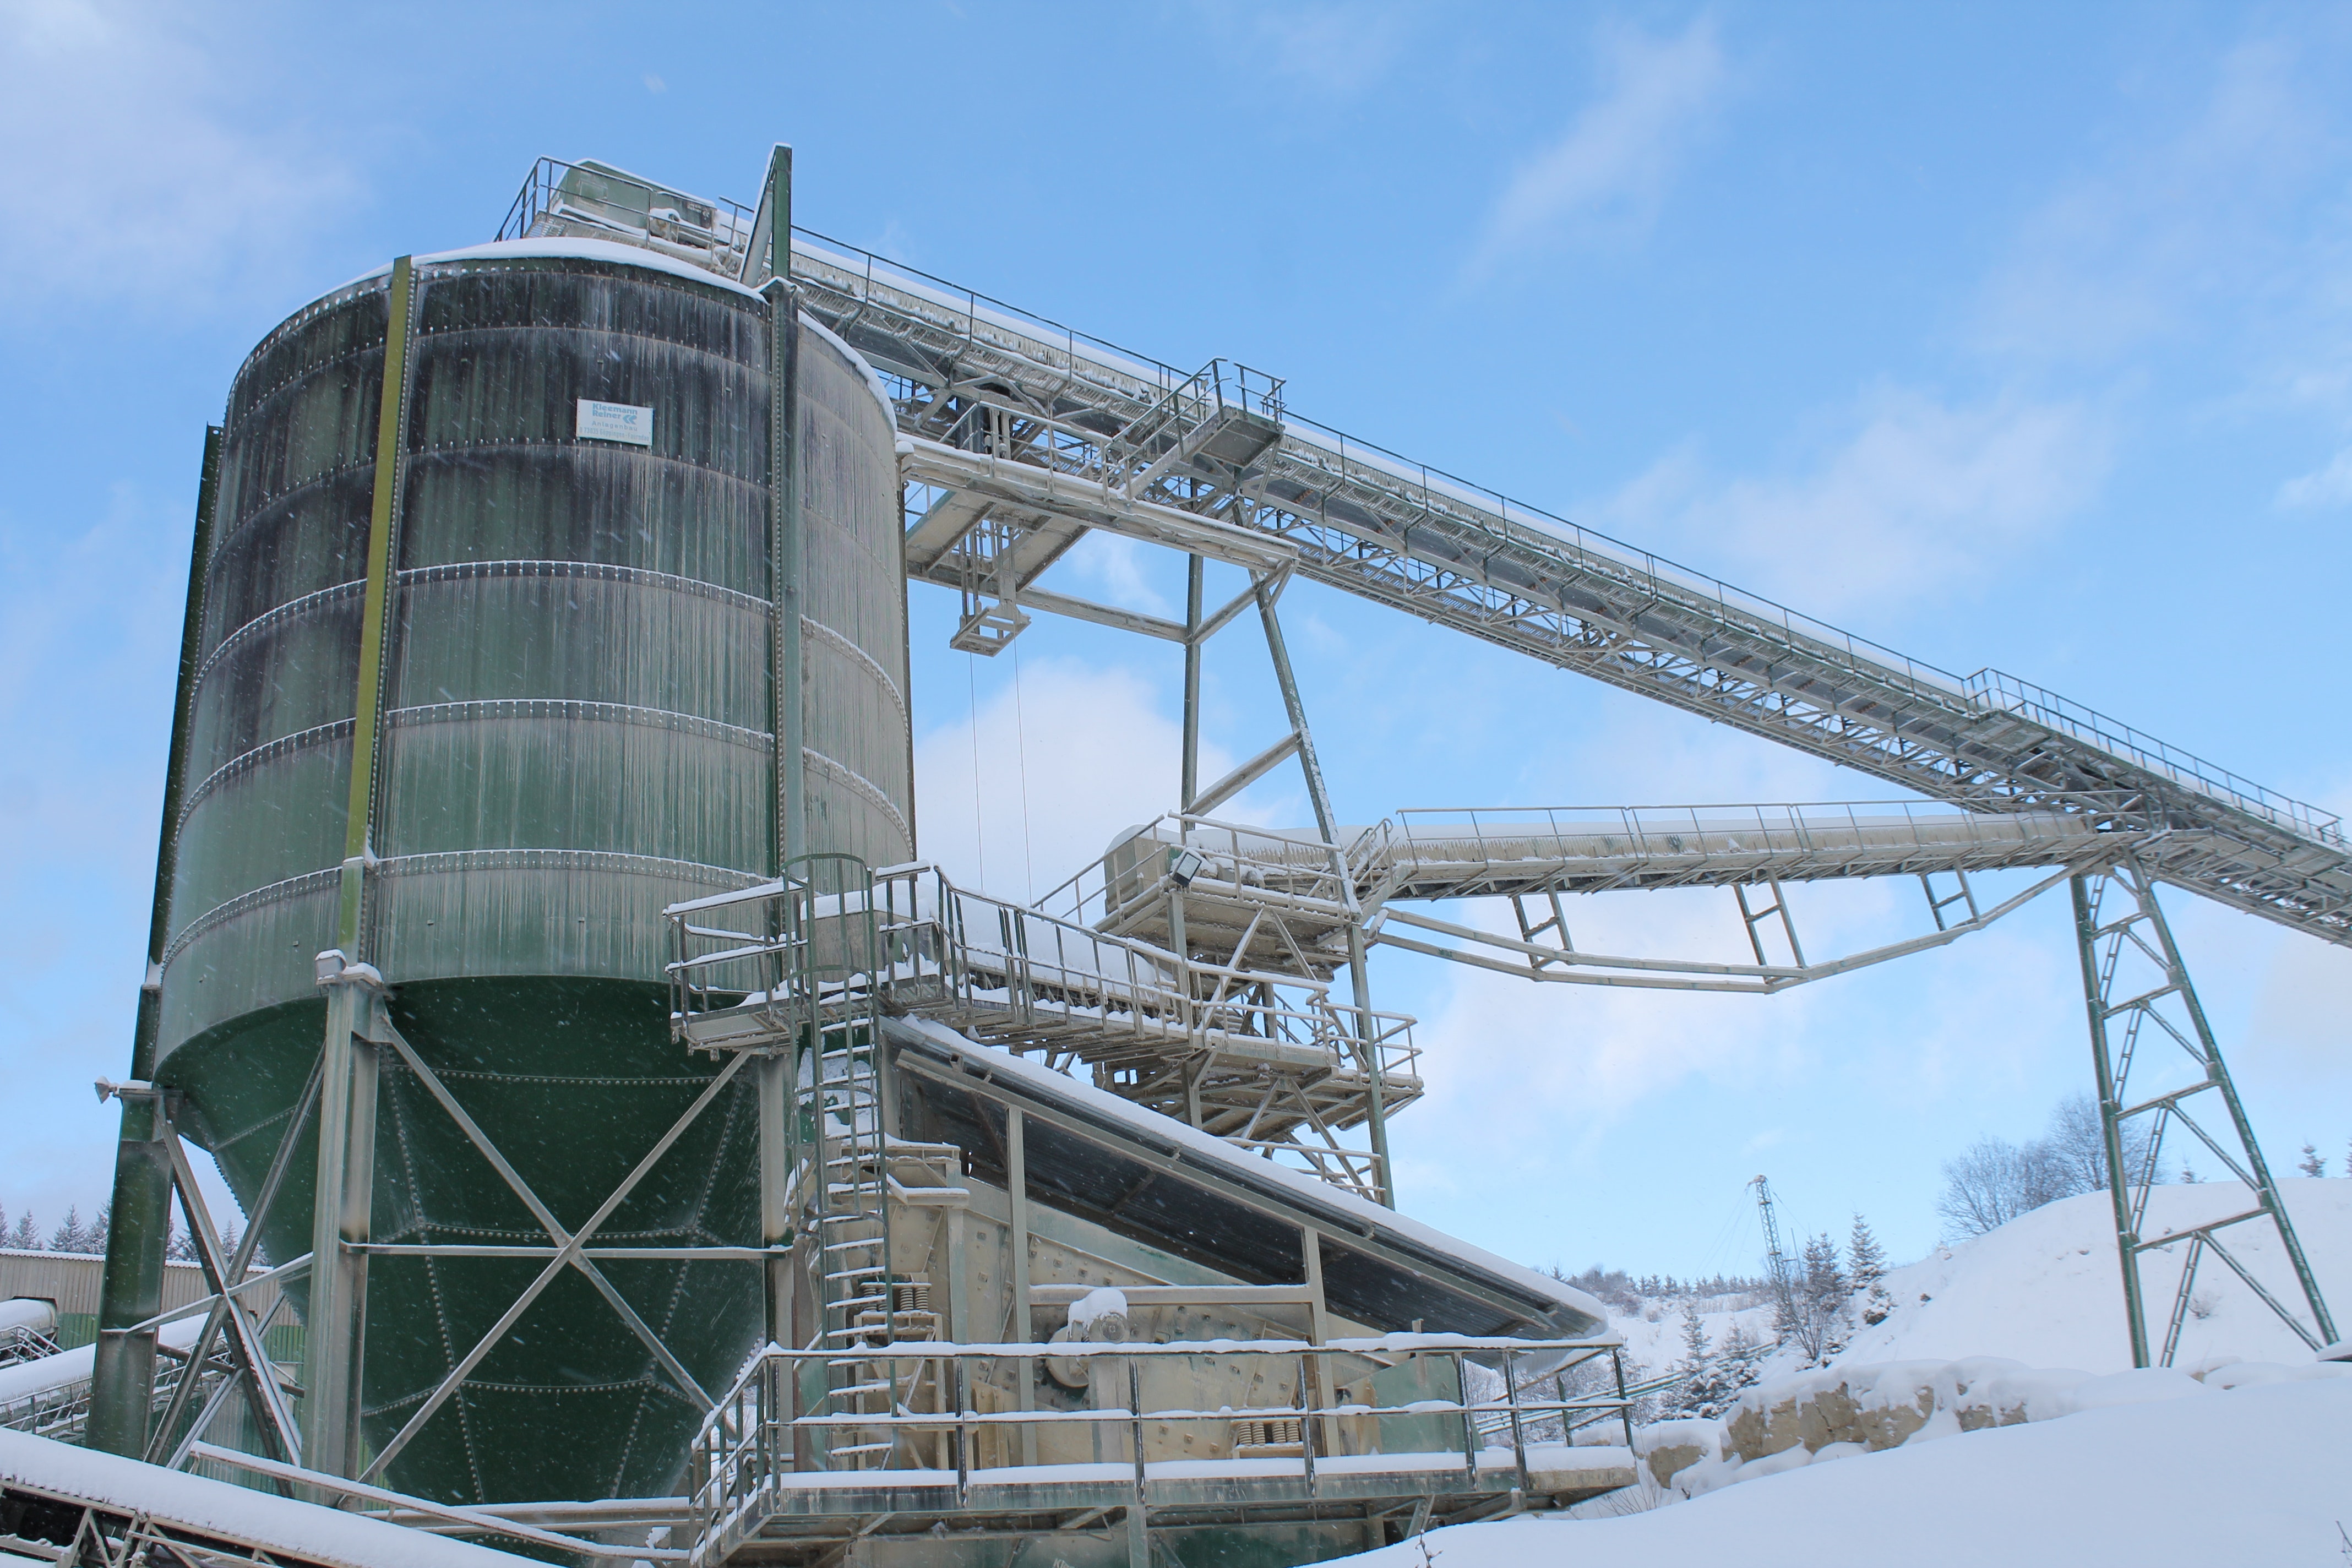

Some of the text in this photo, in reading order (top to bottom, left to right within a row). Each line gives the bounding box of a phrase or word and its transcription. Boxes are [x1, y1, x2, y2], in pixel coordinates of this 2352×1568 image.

[592, 403, 638, 415] Kleemann
[592, 410, 620, 419] Reiner
[592, 421, 638, 432] Anlagenbau
